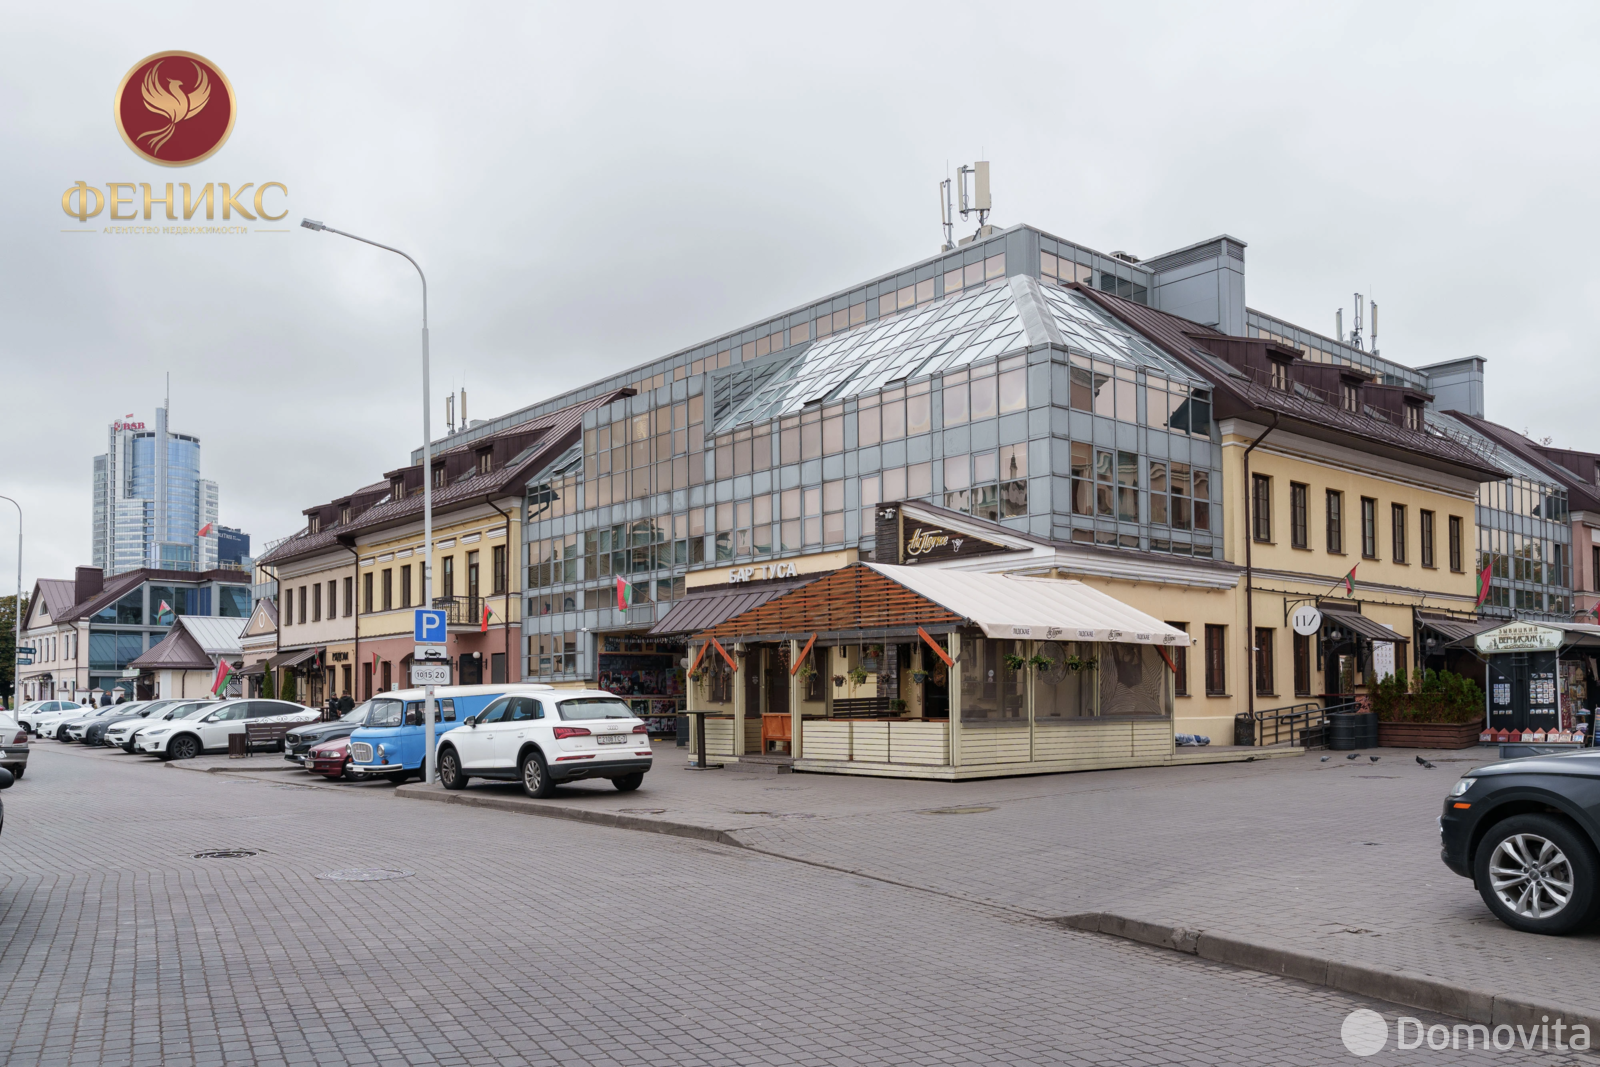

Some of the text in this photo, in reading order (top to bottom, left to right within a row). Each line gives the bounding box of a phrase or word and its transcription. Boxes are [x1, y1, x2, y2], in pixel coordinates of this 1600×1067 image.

[123, 421, 145, 430] BSB
[729, 561, 798, 583] БАР ТУСА
[422, 613, 440, 639] P
[1498, 635, 1538, 644] ВЕРНИСАЖ
[424, 671, 433, 679] 15
[435, 671, 445, 679] 20
